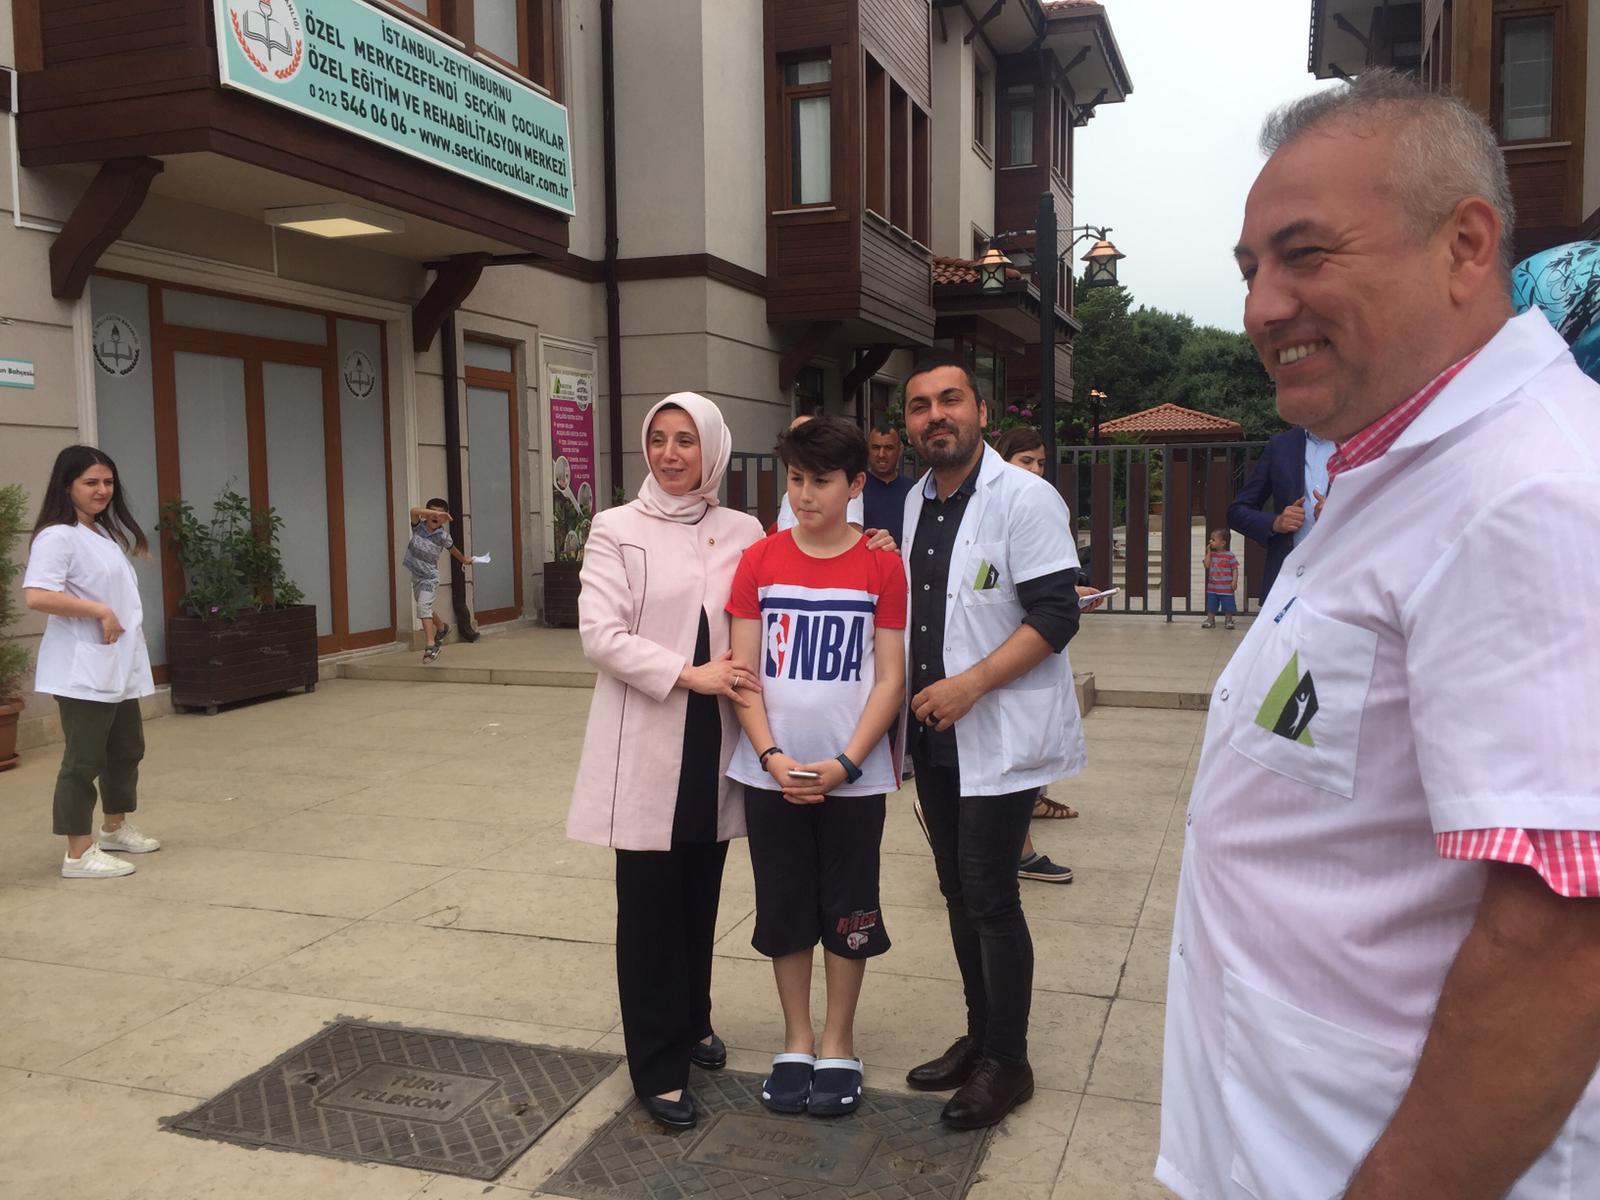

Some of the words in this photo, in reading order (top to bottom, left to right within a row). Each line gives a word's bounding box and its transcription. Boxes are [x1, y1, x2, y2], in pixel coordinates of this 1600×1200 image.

[305, 8, 346, 51] ÖZEL
[353, 36, 458, 103] MERKEZEFENDİ
[464, 91, 506, 125] SEÇKİN
[512, 113, 565, 152] ÇOCUKLAR
[308, 42, 348, 83] ÖZEL
[351, 67, 400, 106] EĞİTİM
[402, 91, 420, 115] VE
[423, 101, 522, 158] REHABİLİTASYON
[524, 145, 566, 177] MERKEZİ
[381, 19, 512, 103] İSTANBUL-ZEYTİNBURNU
[309, 83, 316, 98] 0
[318, 87, 338, 107] 212
[341, 90, 368, 118] 546
[371, 103, 388, 127] 06
[391, 112, 407, 135] 06
[418, 127, 569, 199] www.seckincocuklar.com.tr
[788, 614, 865, 682] NBA
[351, 1087, 452, 1111] TELEKOM
